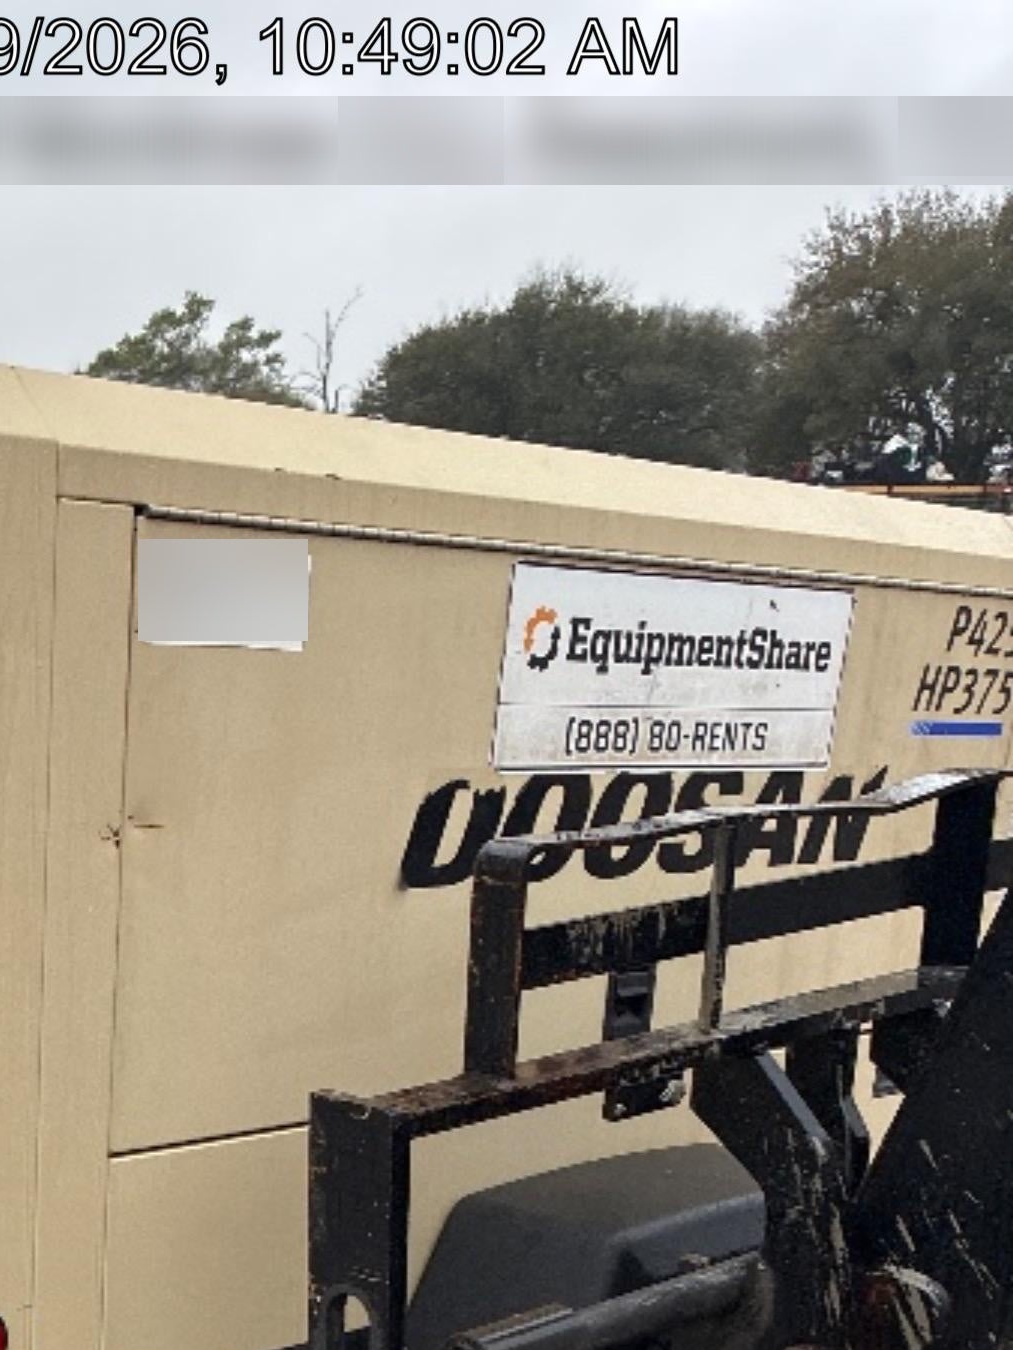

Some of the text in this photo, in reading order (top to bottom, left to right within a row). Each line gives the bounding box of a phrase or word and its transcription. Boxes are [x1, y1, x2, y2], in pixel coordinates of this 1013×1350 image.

[566, 617, 831, 675] EquipmentShare
[565, 716, 769, 754] (888) 80-RENTS
[399, 766, 887, 889] DOOSAN
